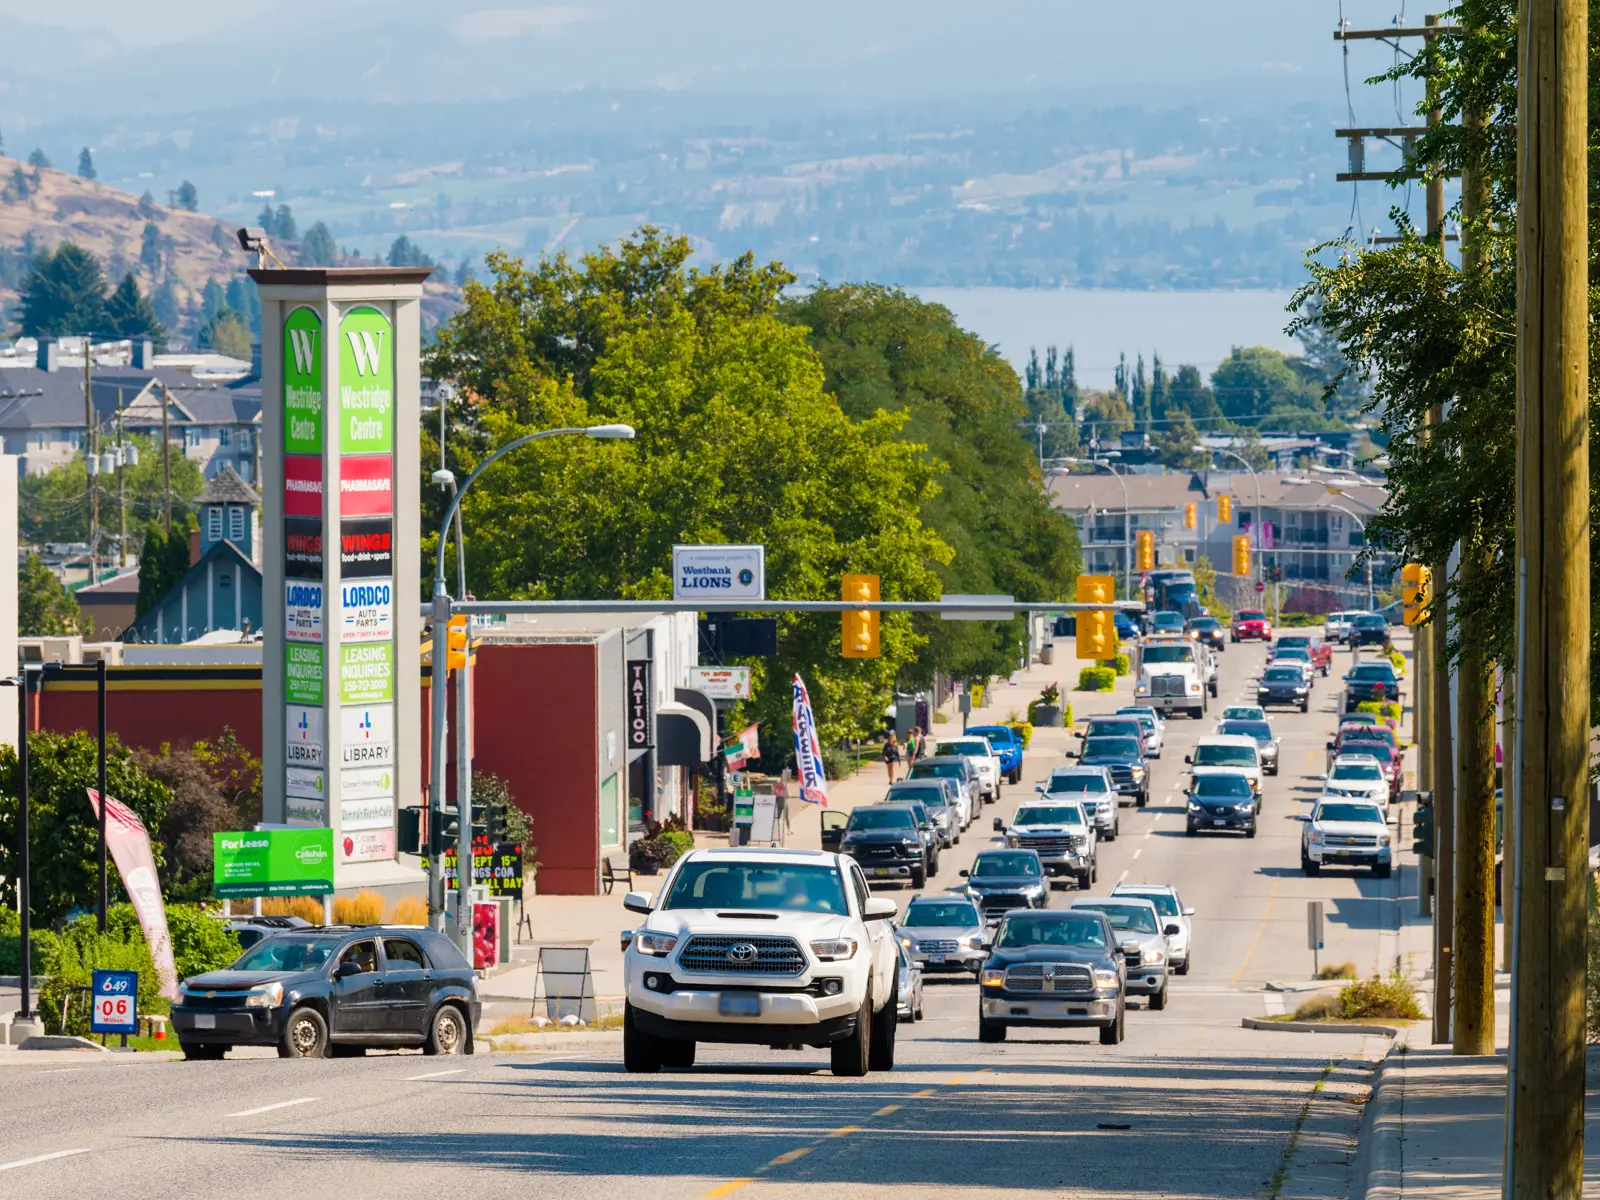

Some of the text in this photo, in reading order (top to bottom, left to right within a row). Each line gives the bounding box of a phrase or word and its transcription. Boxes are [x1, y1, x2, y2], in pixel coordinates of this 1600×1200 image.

[289, 329, 318, 376] W
[346, 330, 385, 377] W
[286, 385, 322, 415] Westridge
[341, 385, 391, 414] Westridge
[291, 416, 316, 440] Centre
[350, 416, 383, 440] Centre
[340, 479, 391, 492] PHARMASAVE
[287, 535, 322, 553] WINGS
[341, 534, 390, 552] WINGS
[683, 566, 731, 575] Westbank
[681, 577, 732, 588] LIONS
[287, 586, 322, 608] LORDCO
[343, 586, 390, 608] LORDCO
[358, 609, 377, 618] AUTO
[356, 619, 378, 628] PARTS
[345, 647, 386, 663] LEASING
[341, 663, 390, 679] INQUIRIES
[632, 666, 645, 743] TATTOO
[288, 747, 322, 763] LIBRARY
[343, 746, 390, 762] LIBRARY
[222, 839, 269, 849] For Lease
[503, 878, 523, 889] DAY
